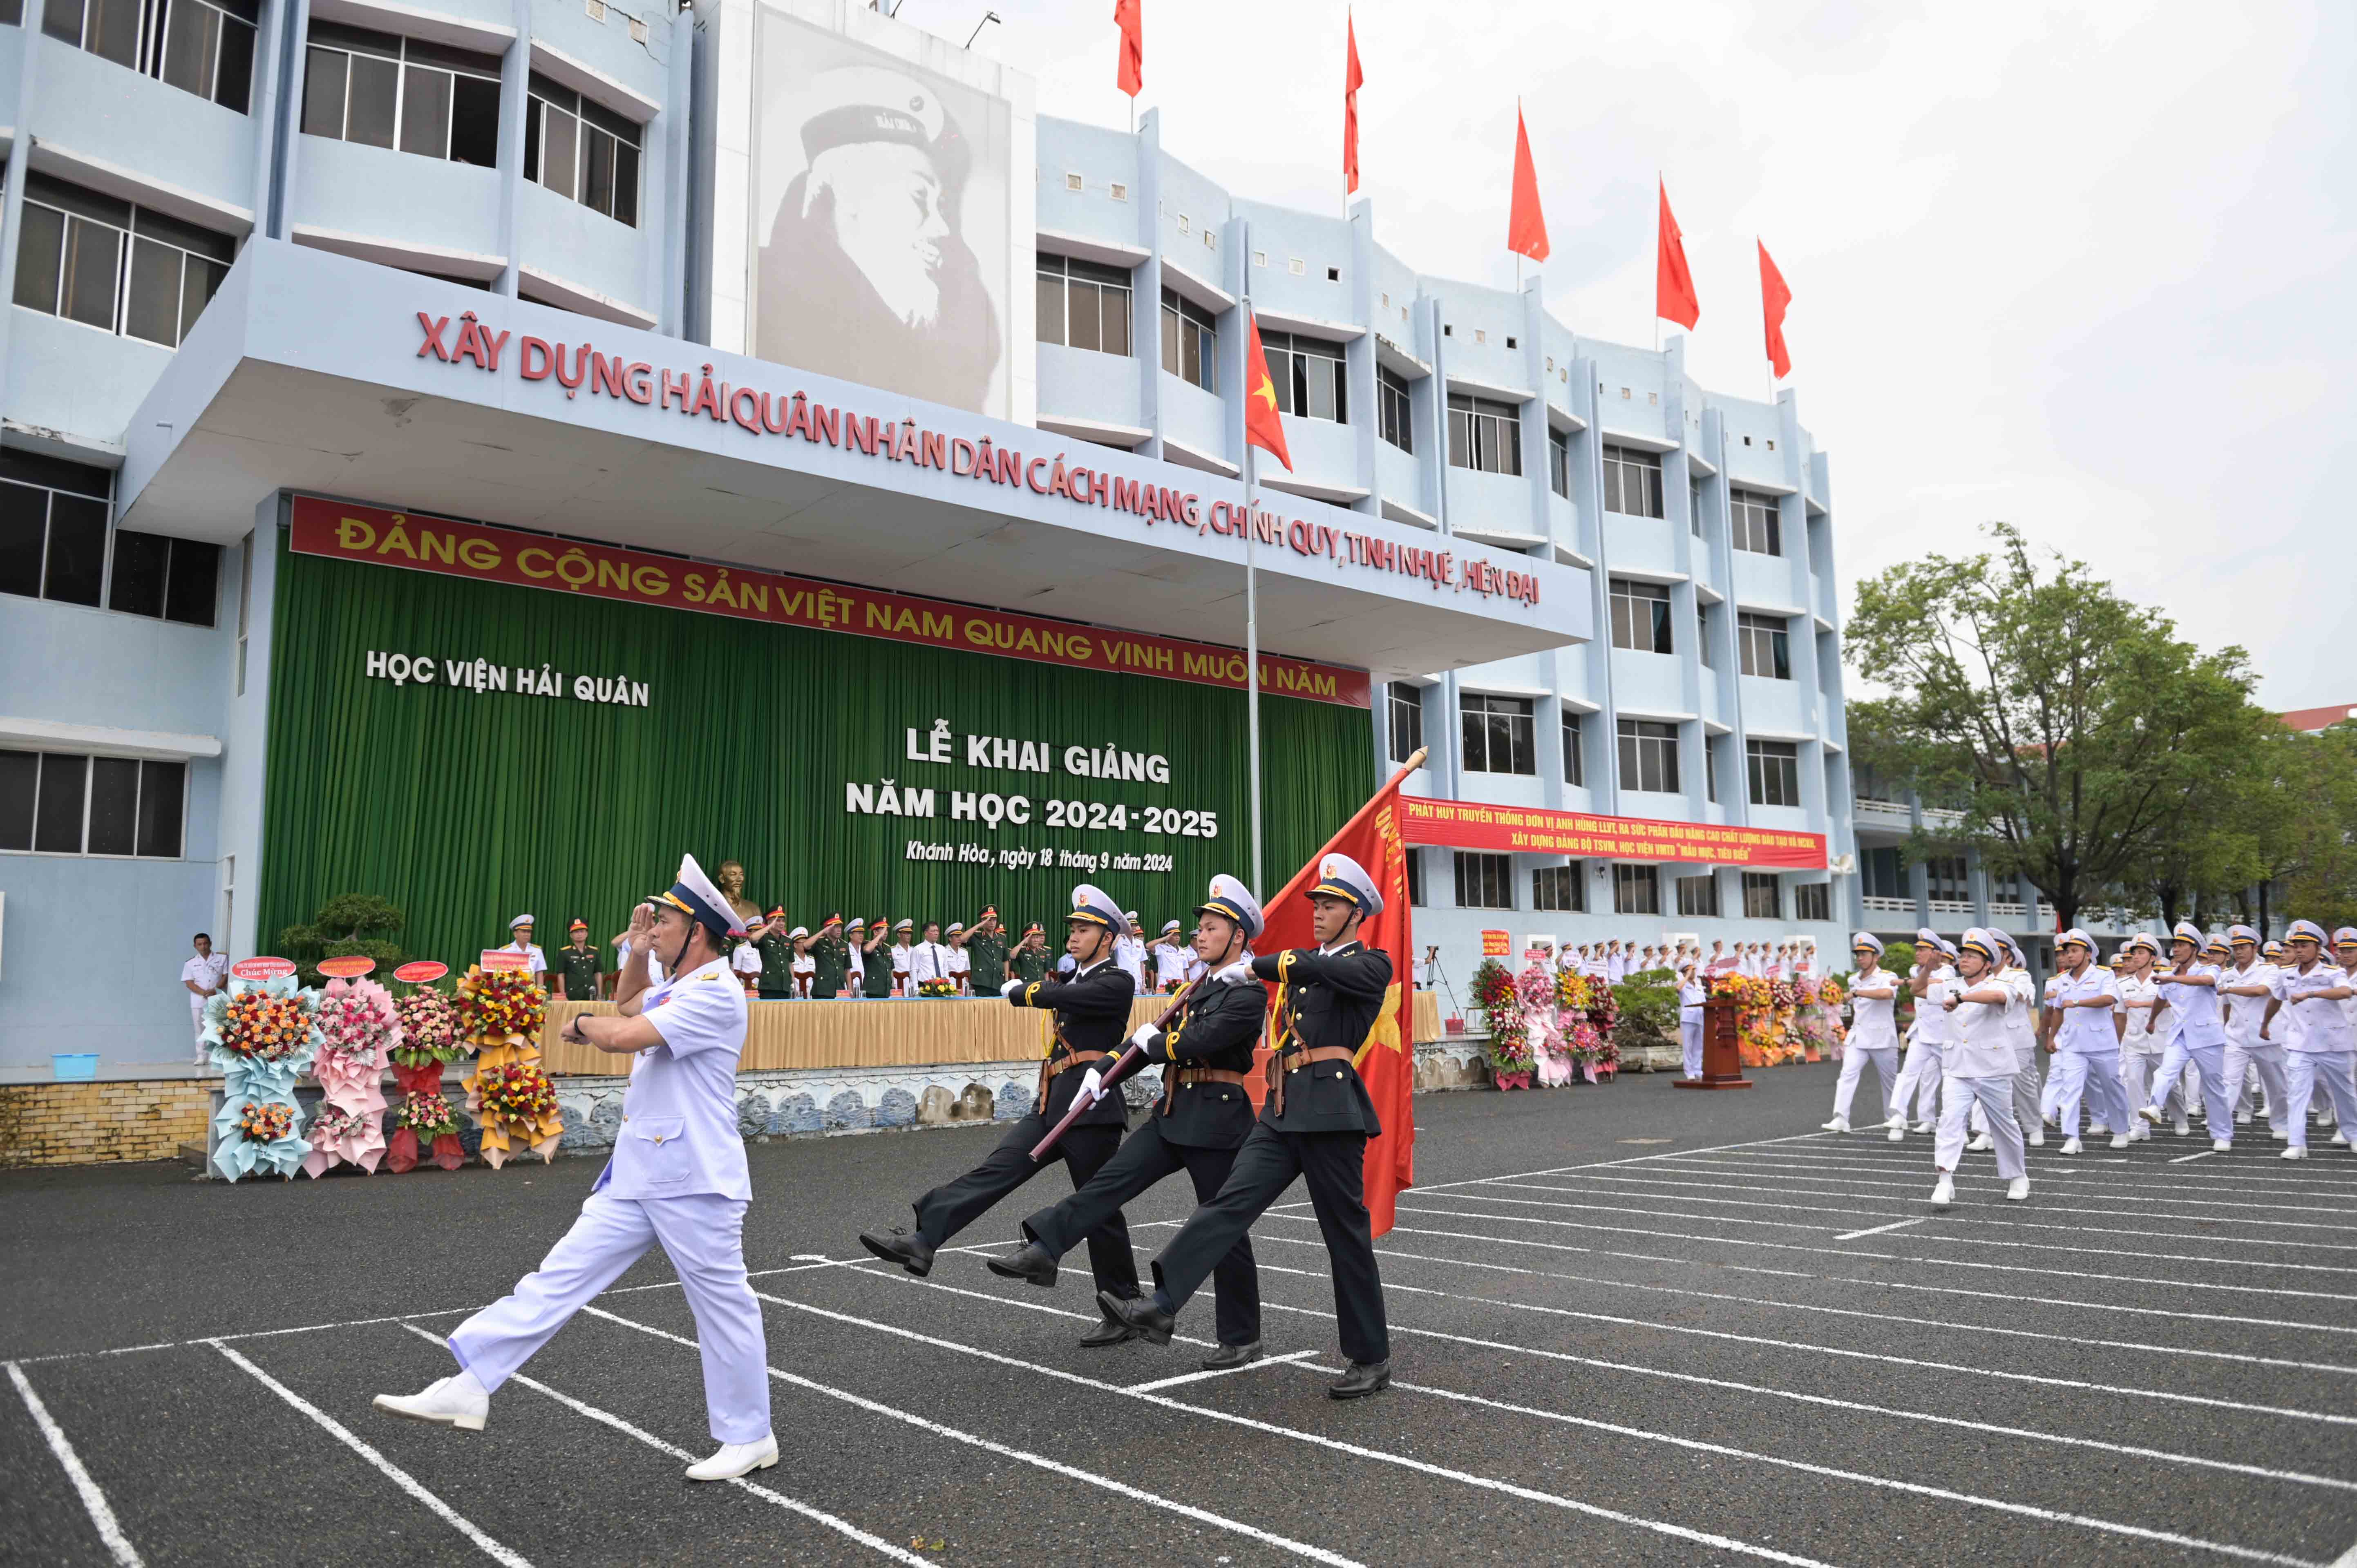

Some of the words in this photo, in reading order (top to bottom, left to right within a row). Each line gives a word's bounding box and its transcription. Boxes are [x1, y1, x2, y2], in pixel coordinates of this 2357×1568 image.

[417, 310, 511, 371] XÂY
[520, 335, 653, 404] DỰNG
[661, 363, 730, 422] HẢI
[731, 387, 839, 447] QUÂN
[846, 412, 945, 470] NHÂN
[953, 435, 1022, 488] DÂN
[1026, 452, 1109, 508] CÁCH
[1114, 476, 1208, 536] MẠNG,
[1288, 519, 1347, 568] QUY,
[1344, 532, 1396, 572] TINH
[1461, 557, 1505, 599] HIỆN
[1507, 570, 1539, 608] ĐẠI
[335, 514, 502, 570] ĐẢNG
[516, 547, 670, 596] CỘNG
[682, 568, 768, 612] SẢN
[776, 587, 854, 627] VIỆT
[866, 602, 953, 640] NAM
[964, 619, 1092, 660] QUANG
[1100, 639, 1174, 672] VINH
[1183, 651, 1268, 686] MUÔN
[1277, 665, 1336, 697] NĂM
[366, 650, 435, 686] HỌC
[445, 657, 507, 693] VIỆN
[516, 663, 562, 697] HẢI
[573, 674, 649, 707] QUÂN
[906, 718, 952, 764] LỄ
[967, 734, 1050, 773] KHAI
[1063, 742, 1170, 784] GIẢNG
[846, 777, 935, 818] NĂM
[951, 791, 1031, 830] HỌC
[1045, 799, 1218, 838] 2024-2025
[1409, 802, 1434, 818] PHÁT
[1436, 805, 1455, 820] HUY
[1494, 809, 1524, 826] THỐNG
[1525, 814, 1544, 828] ĐƠN
[1545, 816, 1554, 831] VỊ
[1556, 817, 1573, 831] ANH
[1575, 817, 1597, 833] HÙNG
[1599, 820, 1618, 835] LLVT,
[1619, 822, 1630, 835] RA
[1631, 822, 1646, 836] SỨC
[1648, 822, 1668, 838] PHẤN
[1669, 823, 1684, 839] ĐẤU
[1706, 830, 1720, 842] CAO
[906, 840, 954, 861] Khánh
[958, 843, 995, 868] Hòa,
[999, 846, 1037, 870] ngày
[1040, 848, 1053, 867] 18
[1059, 849, 1097, 873] tháng
[1100, 851, 1109, 869] 9
[1113, 852, 1141, 870] năm
[1143, 853, 1173, 872] 2024
[1512, 831, 1528, 846] XÂY
[1531, 833, 1554, 850] DỰNG
[1556, 833, 1579, 850] ĐẢNG
[1581, 836, 1592, 853] BỘ
[1593, 839, 1618, 853] TSVM,
[1619, 840, 1635, 856] HỌC
[1636, 840, 1654, 857] VIỆN
[263, 967, 288, 976] Mừng
